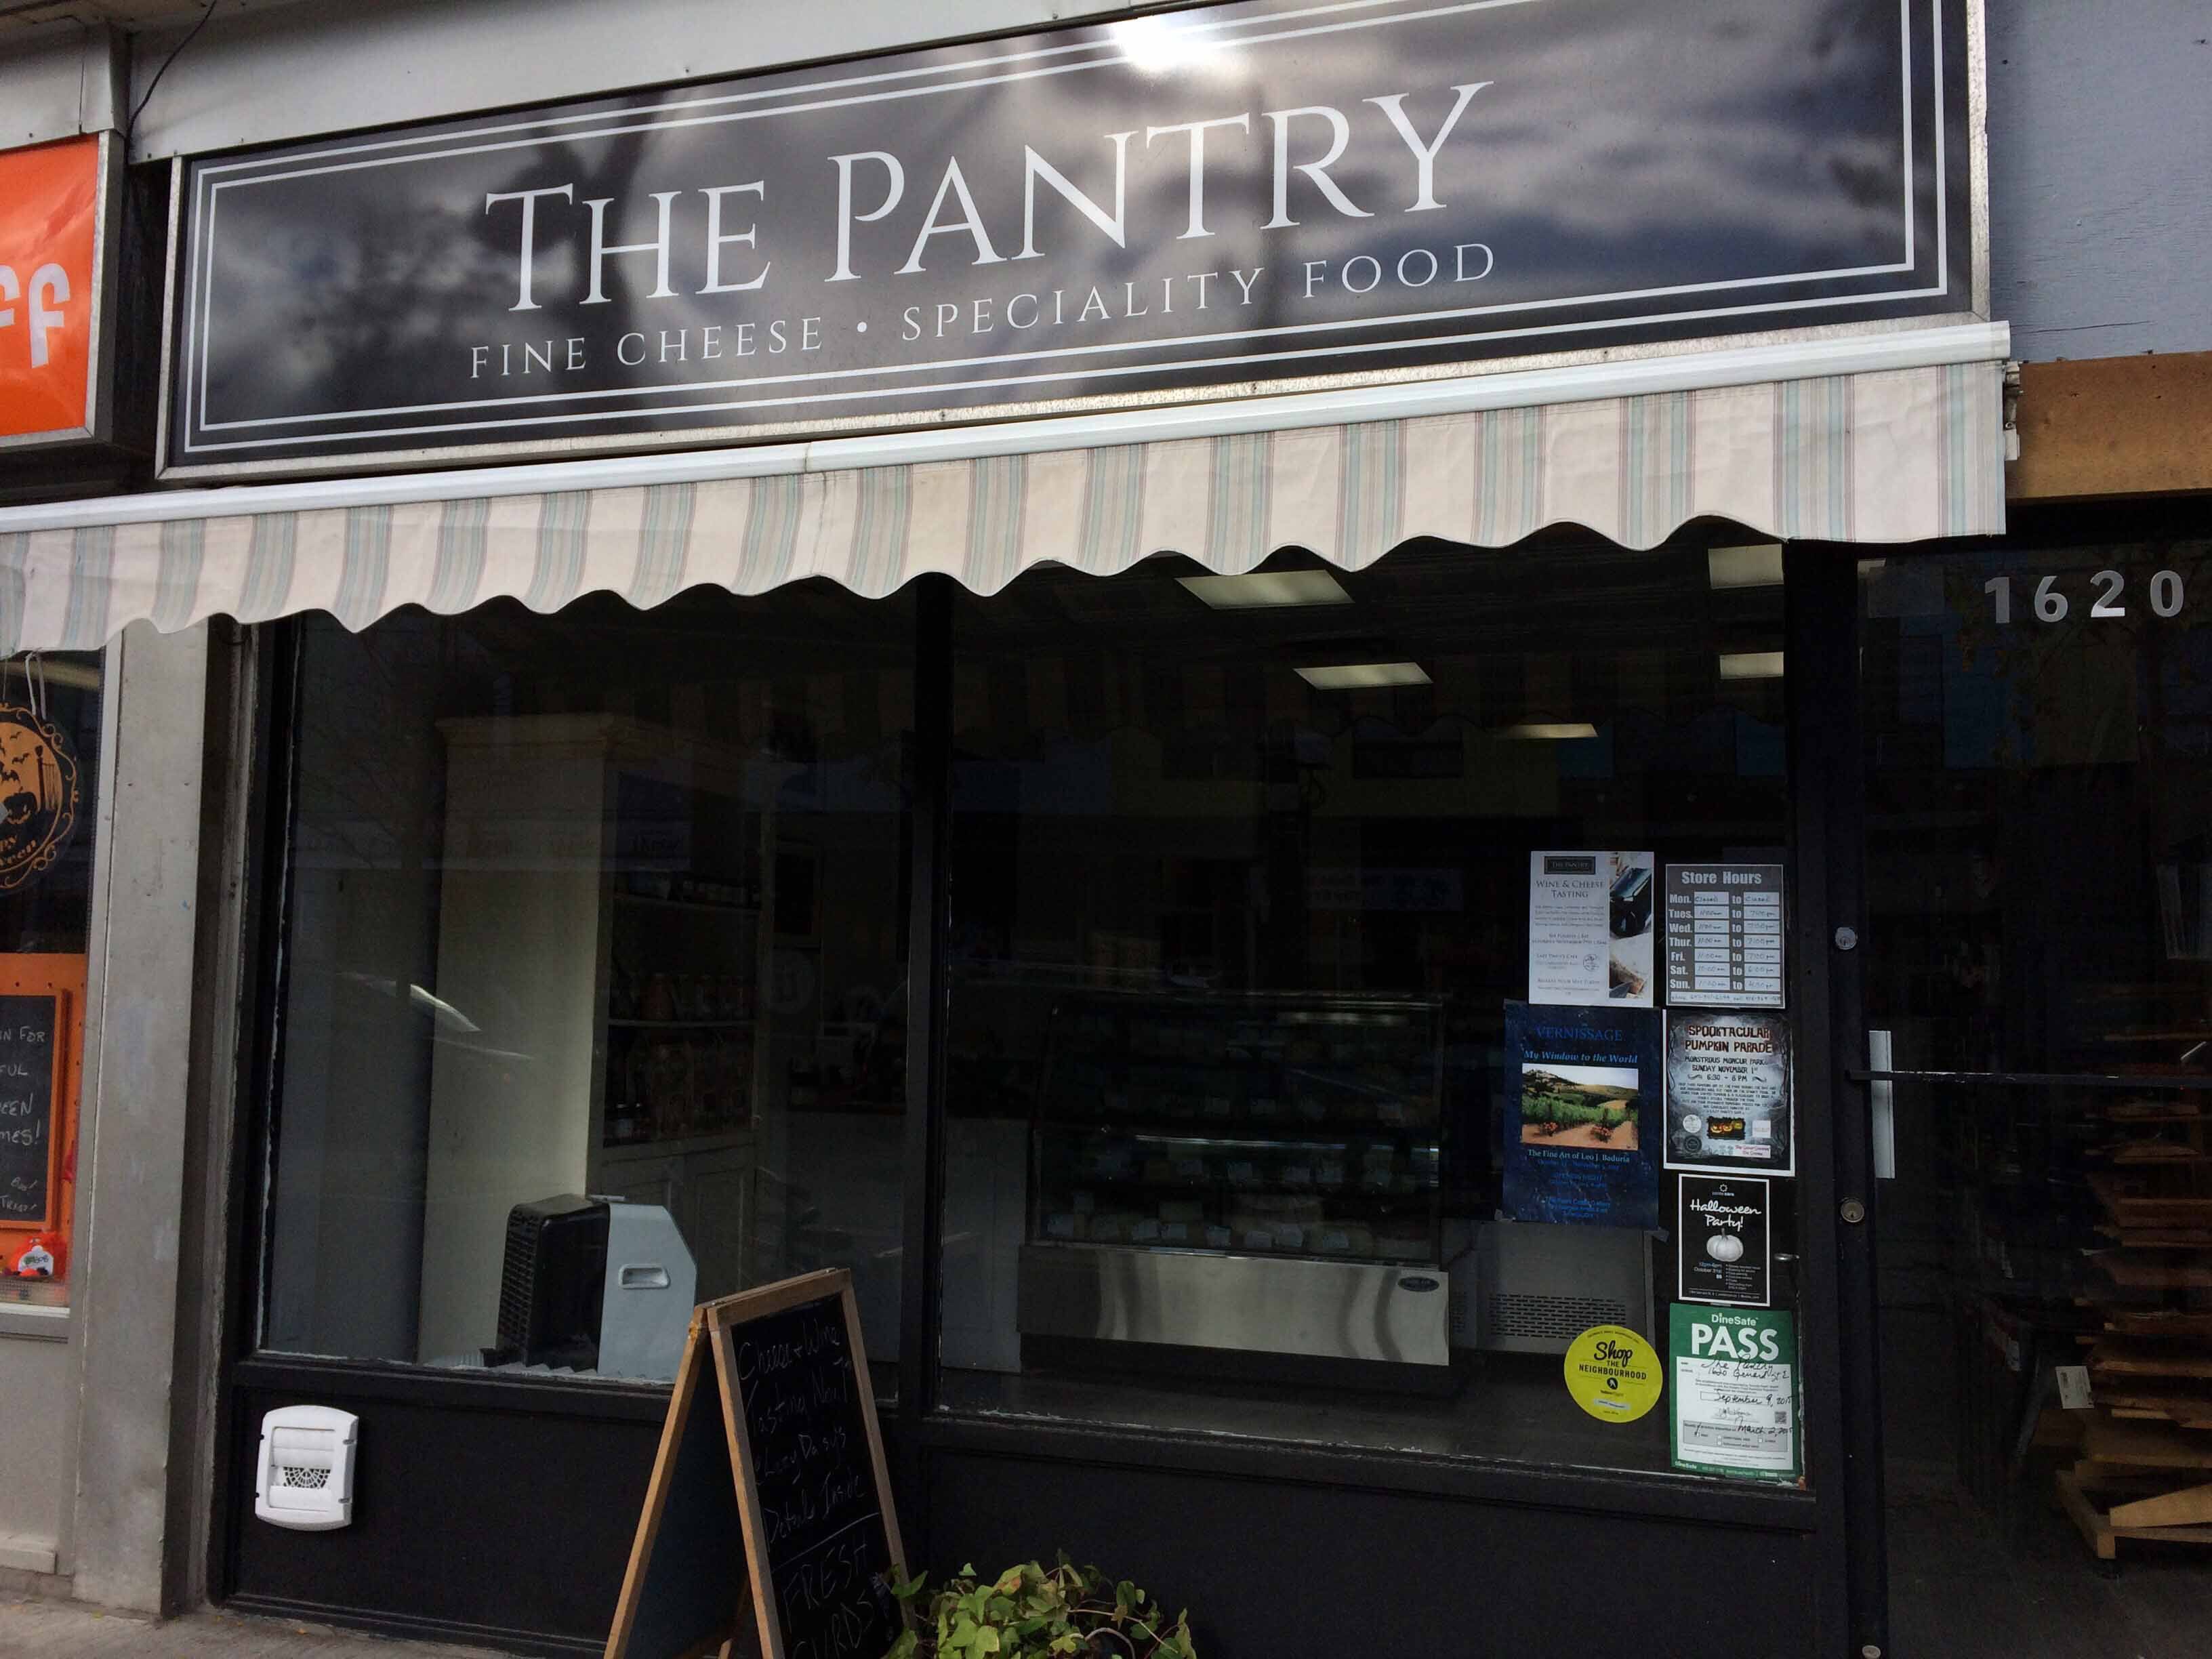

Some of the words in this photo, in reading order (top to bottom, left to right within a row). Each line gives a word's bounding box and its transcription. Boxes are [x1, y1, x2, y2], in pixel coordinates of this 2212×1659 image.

[485, 180, 771, 312] THE
[825, 81, 1494, 282] PANTRY
[470, 337, 586, 379] FINE
[617, 316, 822, 367] CHEESE
[902, 267, 1265, 341] SPECIALITY
[1303, 243, 1494, 299] FOOD
[1984, 569, 2185, 624] 1620
[1681, 871, 1717, 884] Store
[1723, 871, 1762, 884] Hours
[1551, 889, 1589, 898] TASTING
[1669, 894, 1692, 903] Mon.
[1732, 895, 1742, 904] to
[1669, 909, 1693, 918] Tues.
[1732, 909, 1742, 918] to
[1669, 923, 1693, 933] Wed.
[1732, 924, 1742, 933] to
[1669, 937, 1692, 947] Thur.
[1732, 939, 1742, 947] to
[1671, 951, 1685, 961] Fri.
[1732, 953, 1742, 962] to
[1670, 965, 1688, 975] Sat.
[1732, 967, 1742, 976] to
[1670, 979, 1690, 989] Sun.
[1733, 981, 1742, 990] to
[20, 1025, 45, 1043] FOR
[1535, 1025, 1623, 1042] VERNISSAGE
[1688, 1025, 1771, 1039] SPOOKTACULAR
[1685, 1040, 1729, 1052] PUMPKIN
[1734, 1041, 1773, 1053] PARADE
[1523, 1050, 1540, 1061] My
[1542, 1051, 1578, 1061] Window
[1581, 1053, 1591, 1062] to
[1593, 1052, 1606, 1063] the
[1609, 1054, 1638, 1063] World
[1685, 1055, 1721, 1064] MONSTROUS
[1692, 1064, 1716, 1073] SUNDAY
[1528, 1149, 1542, 1157] The
[1542, 1150, 1558, 1158] Fine
[1689, 1198, 1762, 1215] Halloween
[1704, 1214, 1744, 1232] Party!
[1711, 1313, 1757, 1327] DineSafe
[1692, 1323, 1780, 1361] PASS
[1593, 1340, 1633, 1368] Shop
[1606, 1359, 1620, 1368] THE
[1578, 1364, 1647, 1380] NEIGHBOURHOOD
